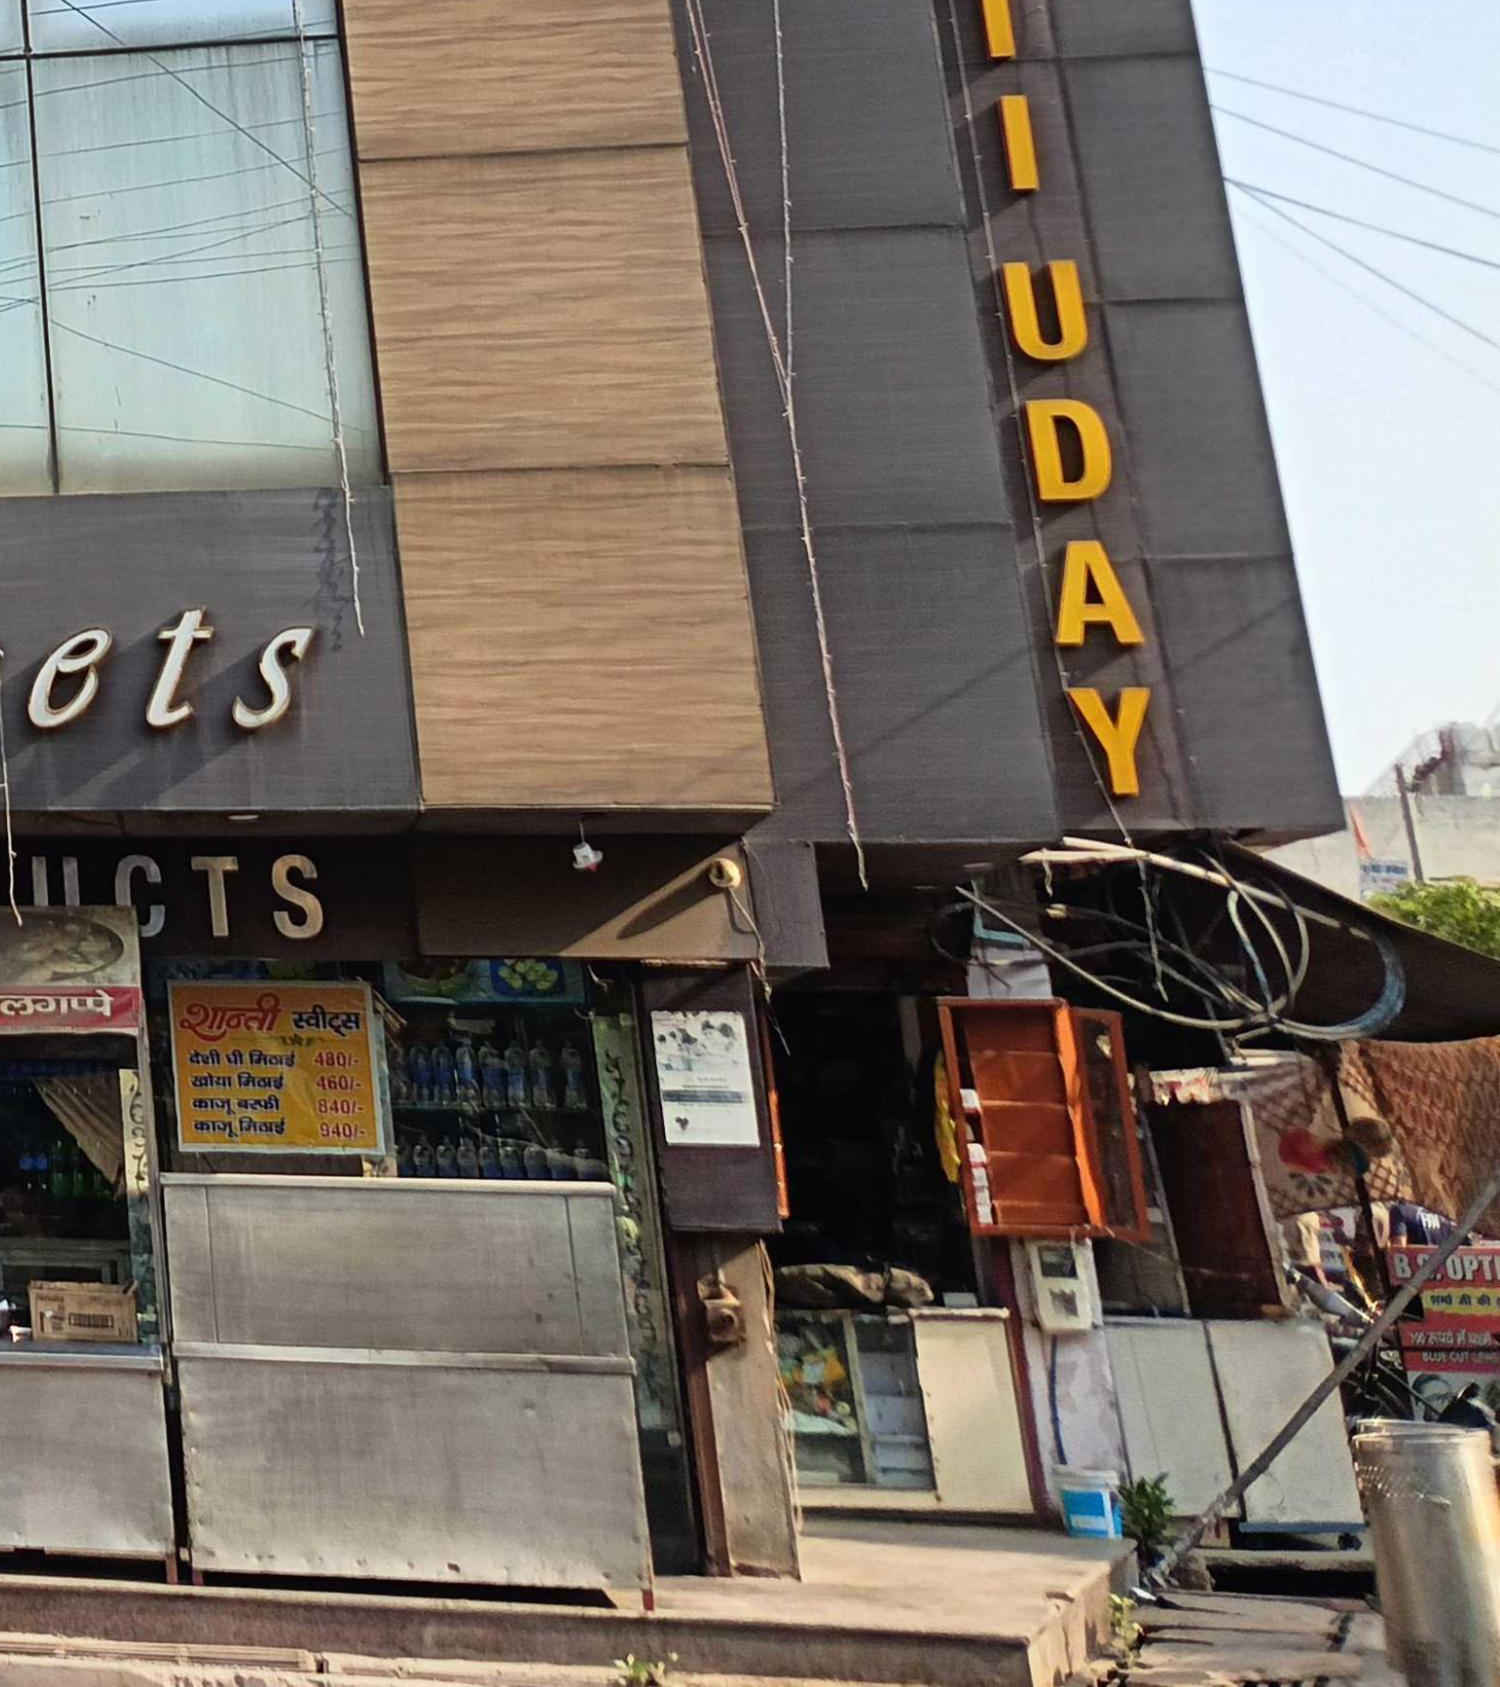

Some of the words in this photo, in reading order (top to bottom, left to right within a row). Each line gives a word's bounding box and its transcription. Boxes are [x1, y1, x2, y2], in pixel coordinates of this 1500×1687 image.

[1003, 260, 1151, 795] UDAY
[179, 992, 283, 1042] शान्ती
[292, 1004, 361, 1037] स्वीट्स
